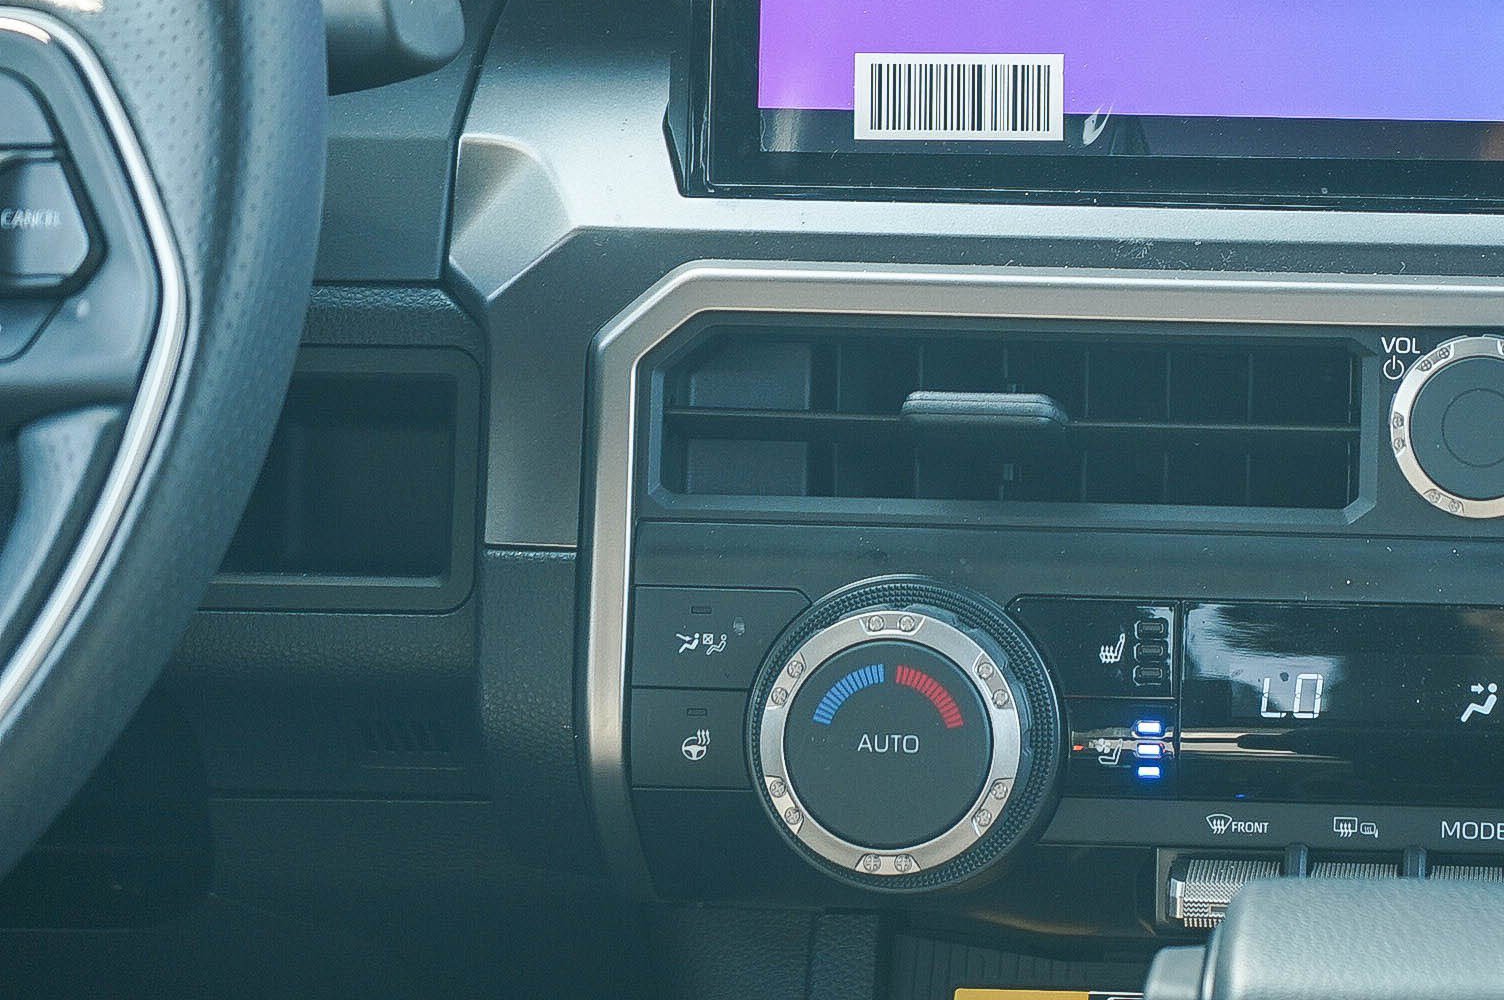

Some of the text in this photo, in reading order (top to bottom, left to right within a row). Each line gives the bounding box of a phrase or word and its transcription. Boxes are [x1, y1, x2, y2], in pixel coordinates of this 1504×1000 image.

[1381, 336, 1421, 354] VOL
[856, 733, 920, 754] AUTO
[1231, 820, 1270, 835] FRONT
